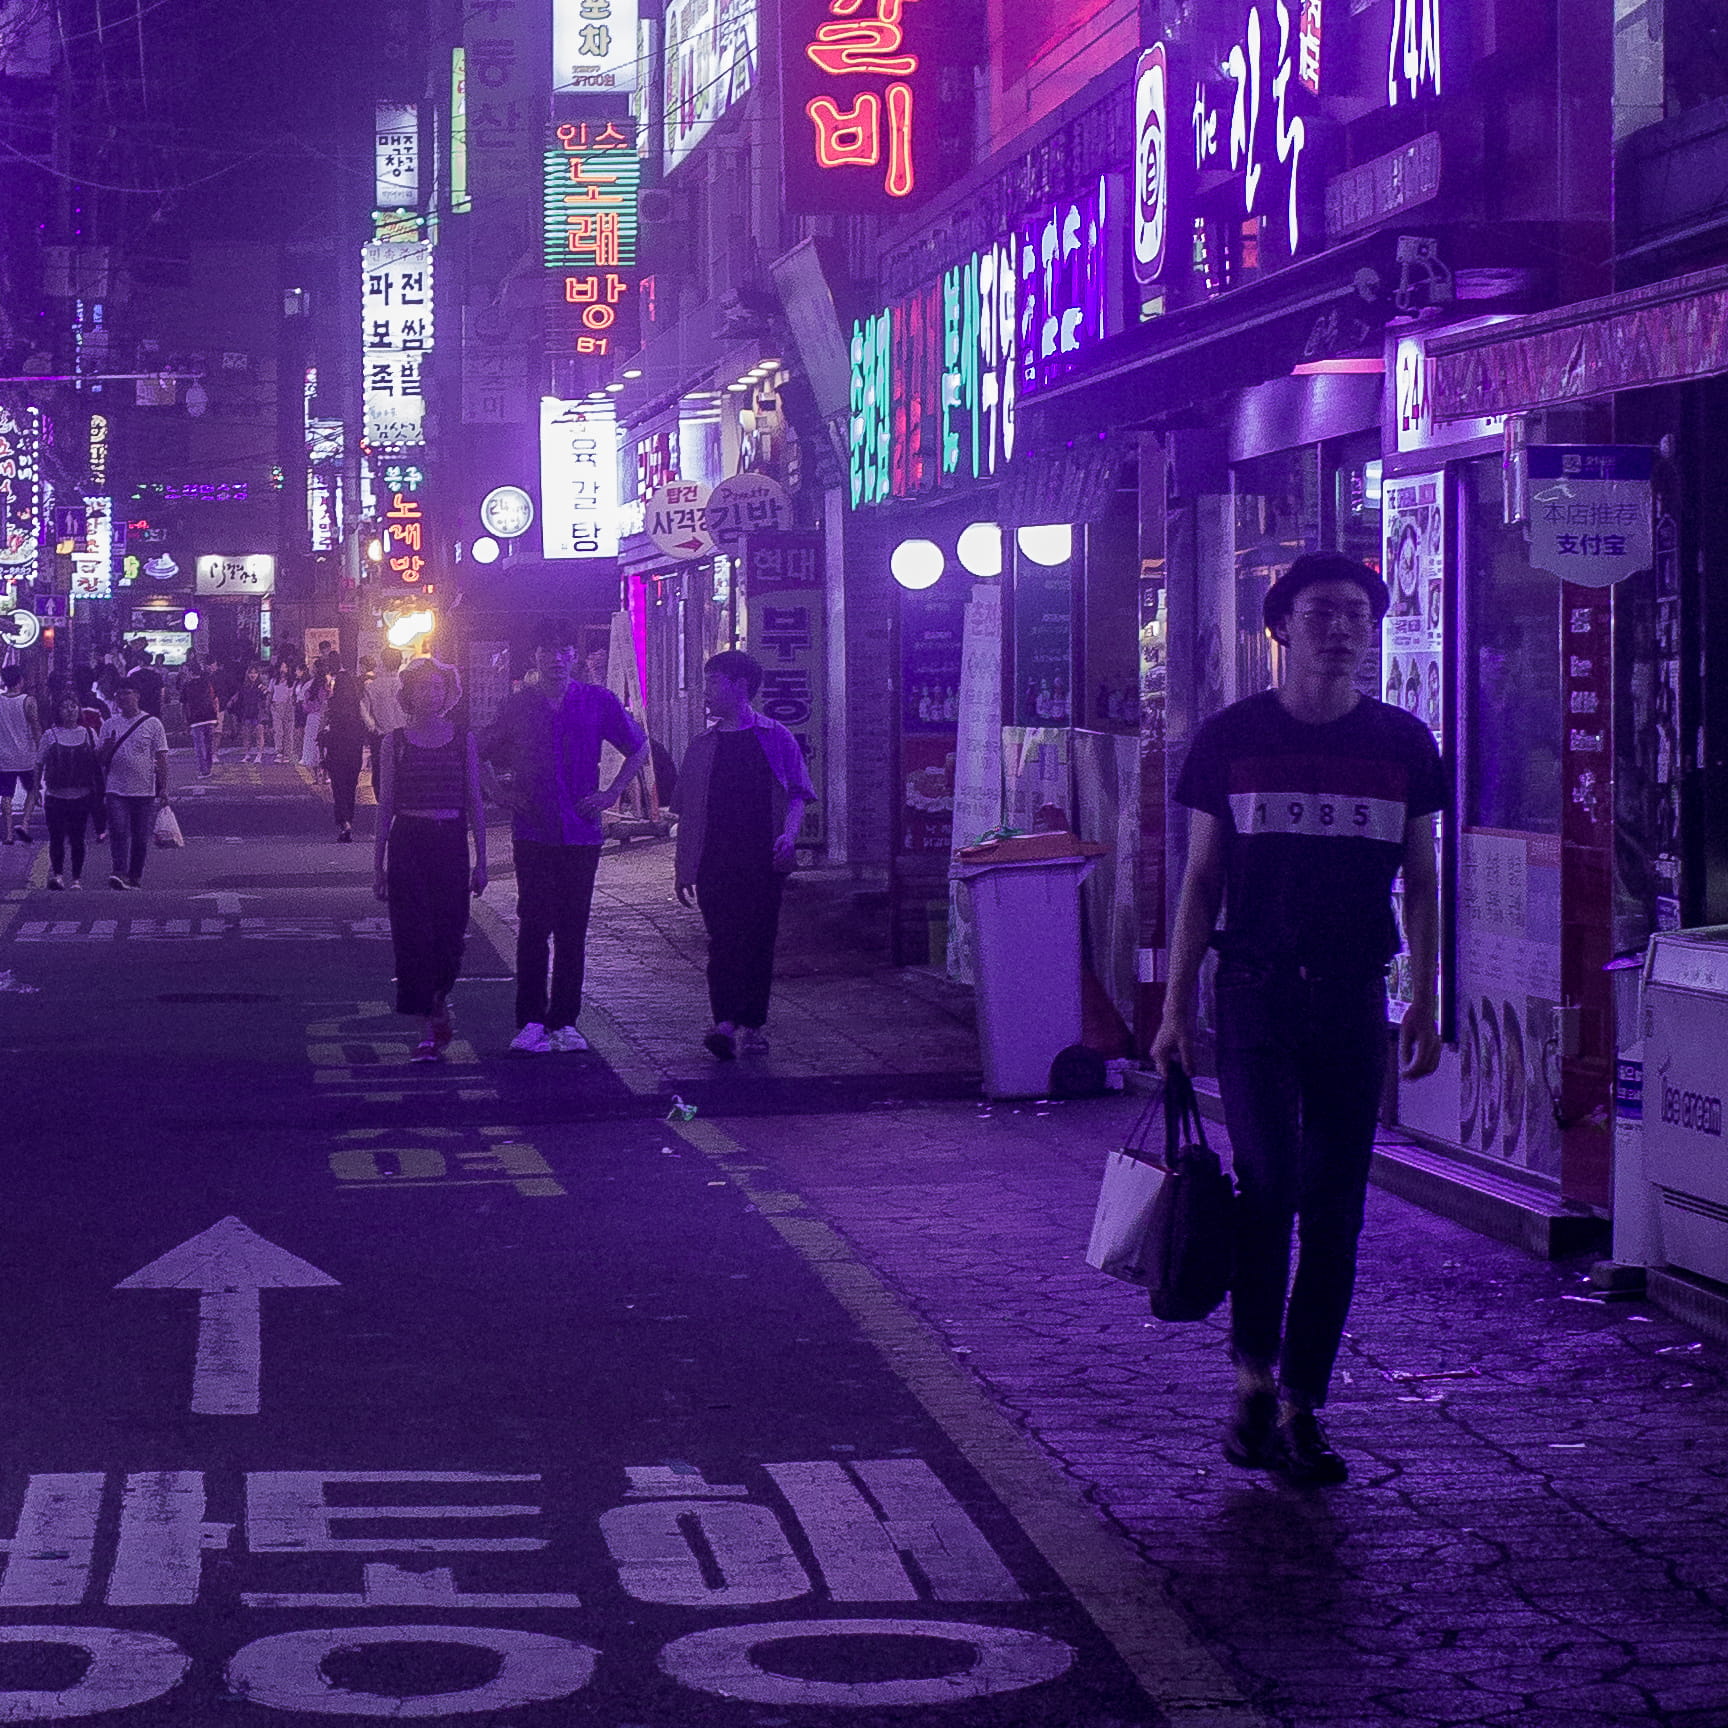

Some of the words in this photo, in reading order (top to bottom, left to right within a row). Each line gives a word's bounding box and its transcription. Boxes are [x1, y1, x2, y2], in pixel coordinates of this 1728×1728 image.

[556, 122, 628, 151] 인스
[1192, 82, 1218, 170] the
[1223, 4, 1305, 257] 진국
[563, 157, 627, 331] 노래방
[368, 271, 424, 307] 파전
[368, 317, 426, 352] 보쌈
[1543, 502, 1640, 526] 本店推荐
[386, 492, 425, 583] 노래방
[1556, 532, 1627, 557] 支付宝
[1255, 801, 1371, 830] 1985
